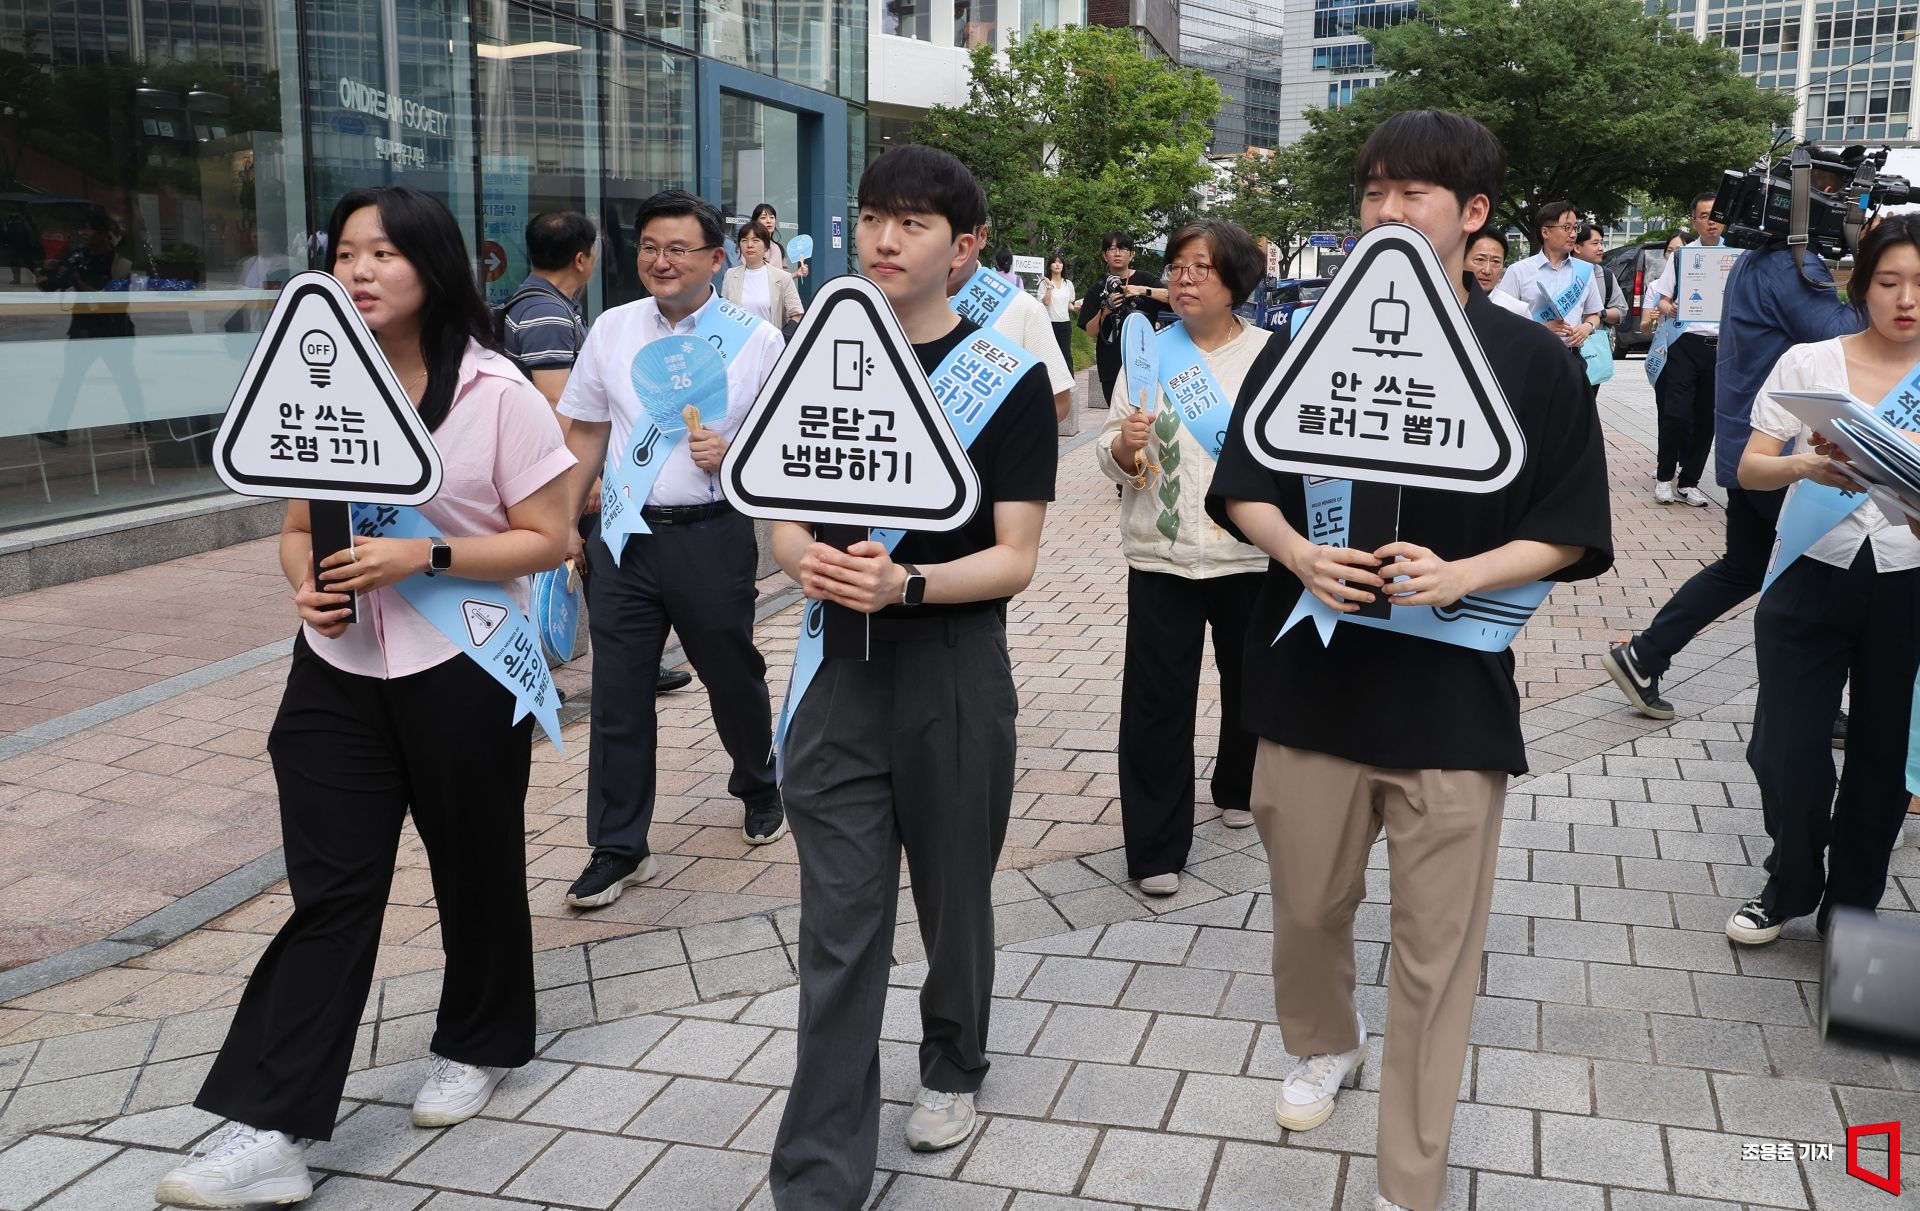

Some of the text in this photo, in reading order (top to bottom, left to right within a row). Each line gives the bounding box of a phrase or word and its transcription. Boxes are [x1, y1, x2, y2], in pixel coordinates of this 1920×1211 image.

[340, 77, 448, 136] ONDREAM SOCIETY
[1015, 260, 1032, 269] PAGE
[720, 303, 753, 327] 하기
[956, 299, 989, 327] 실내
[969, 285, 1000, 312] 적정
[307, 344, 330, 355] OFF
[969, 339, 1021, 374] 문닫고
[950, 352, 1004, 399] 냉방
[1168, 365, 1202, 389] 문닫고
[1175, 377, 1208, 405] 냉방
[1330, 371, 1436, 410] 안 쓰는
[933, 375, 983, 424] 하기
[1185, 392, 1218, 421] 하기
[279, 402, 366, 434] 안 쓰는
[798, 405, 897, 443] 문닫고
[1297, 404, 1465, 449] 플러그 뽑기
[270, 434, 380, 466] 조명 끄기
[782, 444, 912, 485] 냉방하기
[1313, 506, 1345, 537] 온도
[504, 632, 533, 678] 온도
[519, 650, 542, 692] 주의
[534, 668, 549, 707] 캠페인
